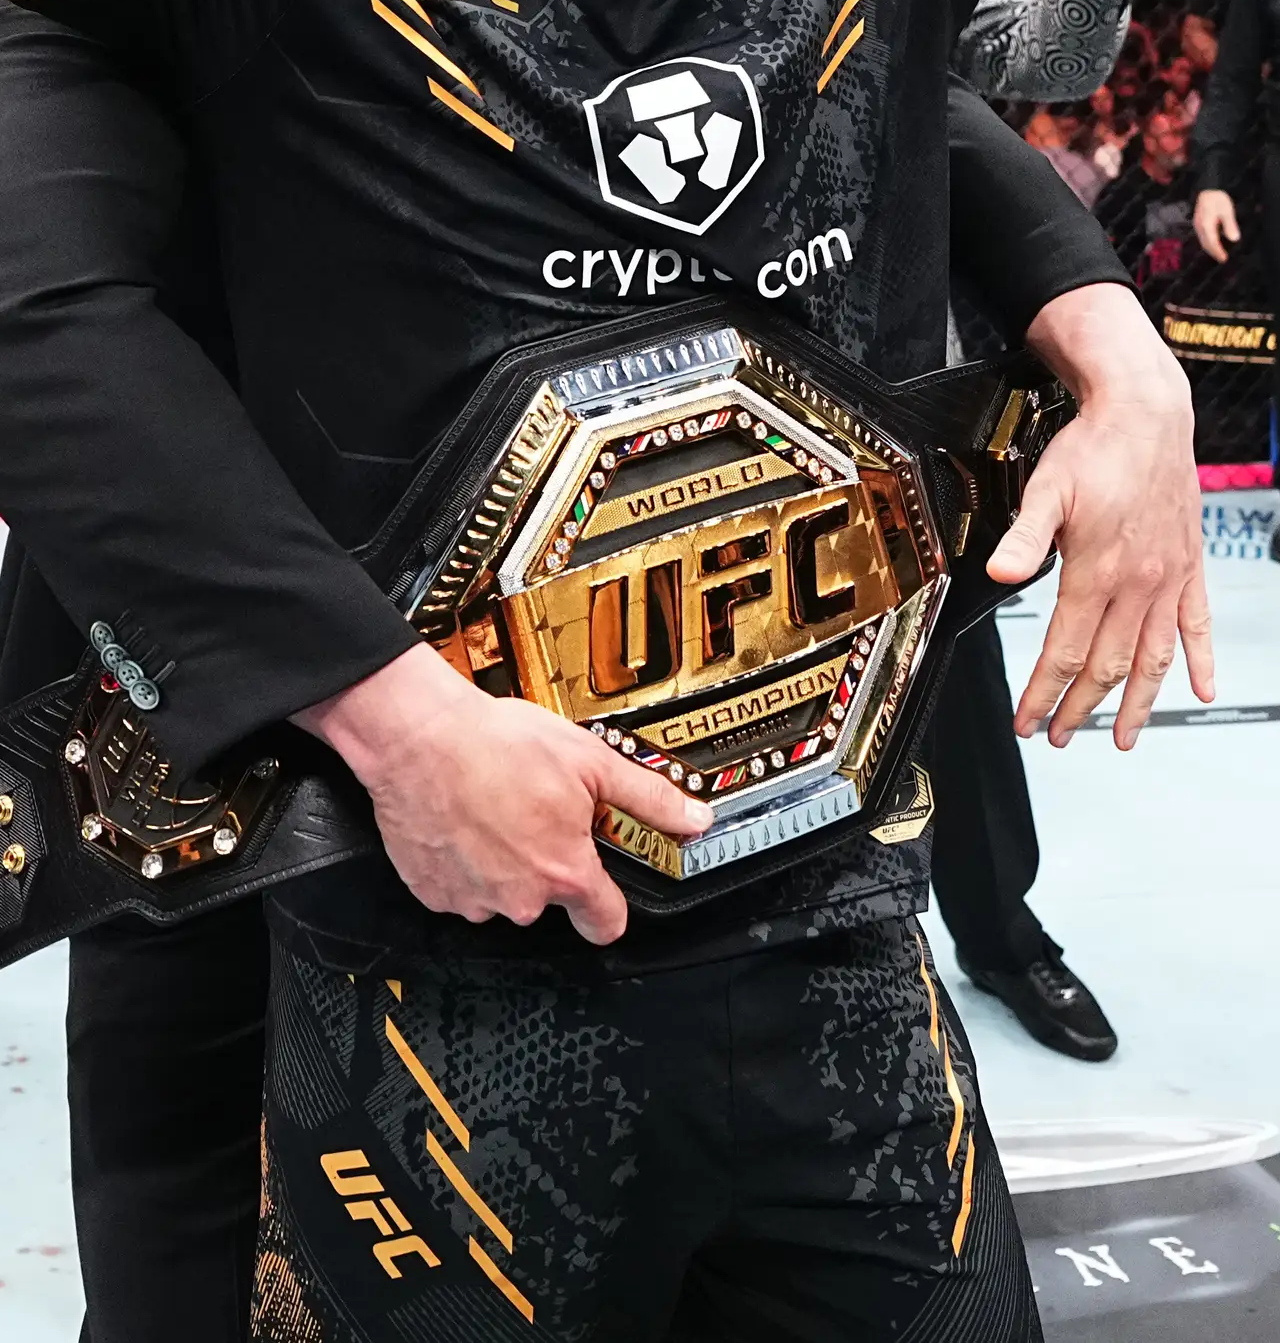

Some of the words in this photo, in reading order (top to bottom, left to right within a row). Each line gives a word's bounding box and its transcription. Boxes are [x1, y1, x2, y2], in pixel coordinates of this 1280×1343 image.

[626, 459, 767, 519] WORLD
[587, 498, 858, 698] UFC
[661, 666, 838, 745] CHAMPION
[900, 809, 927, 821] PRODUCT
[320, 1148, 442, 1280] UFC
